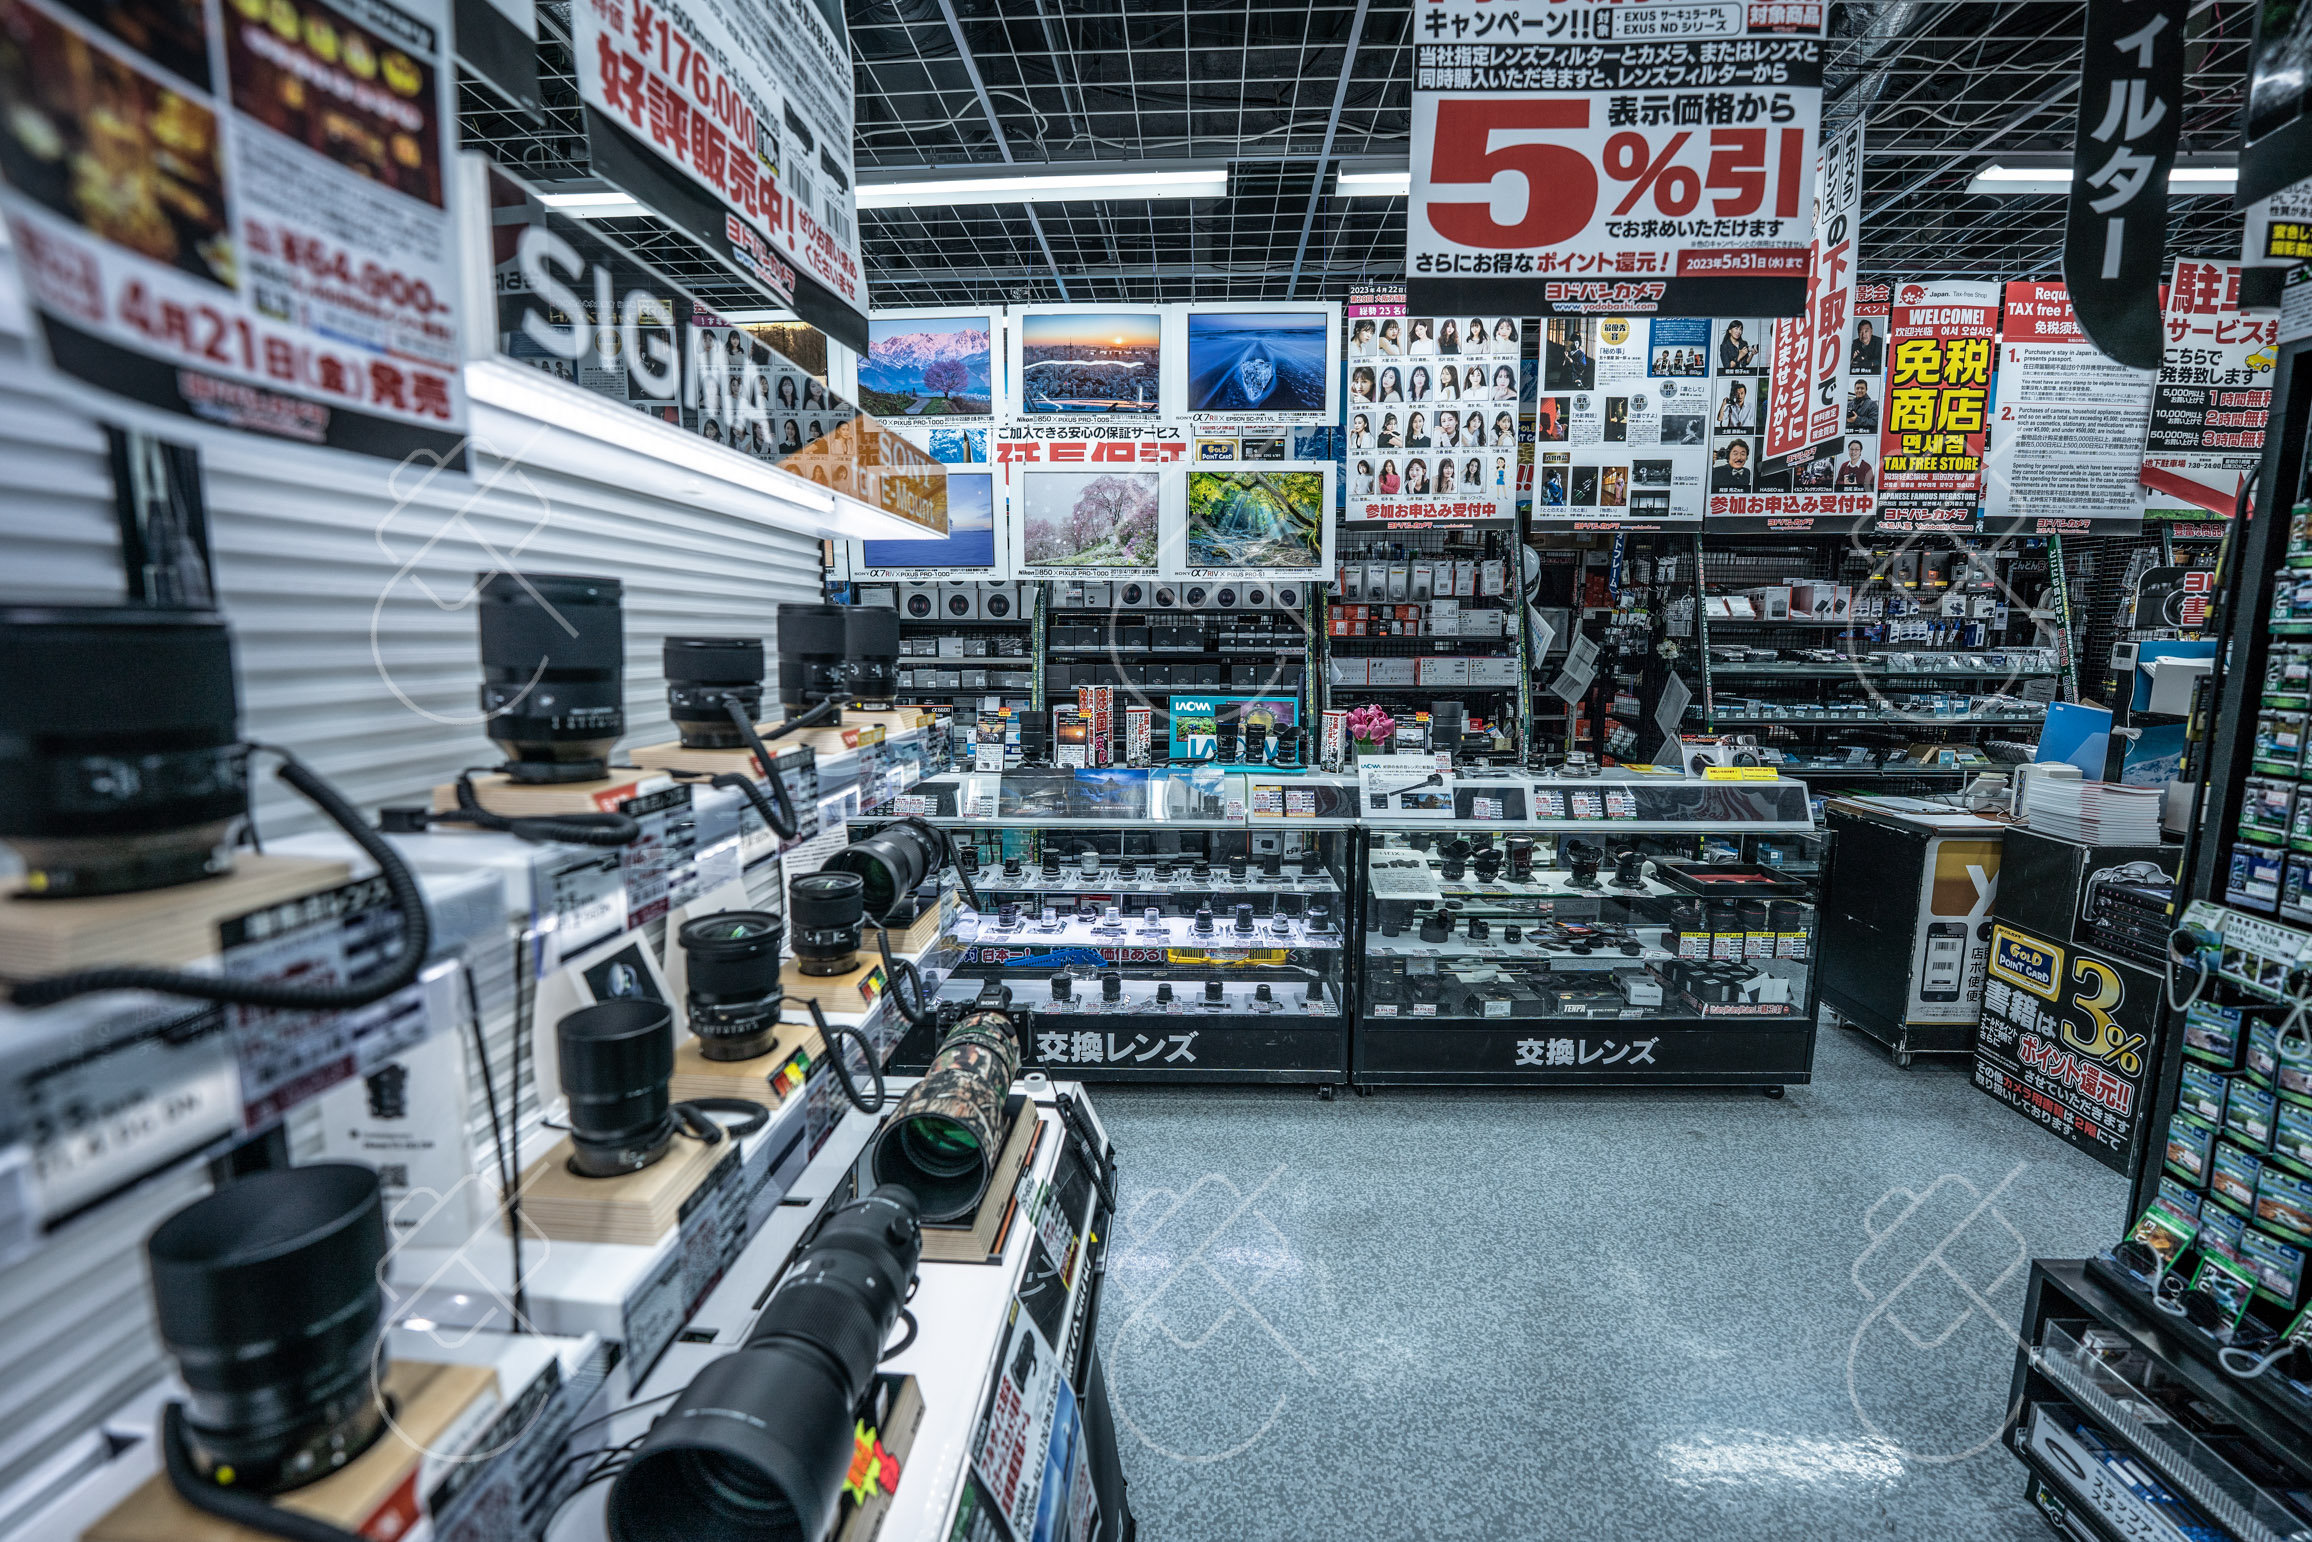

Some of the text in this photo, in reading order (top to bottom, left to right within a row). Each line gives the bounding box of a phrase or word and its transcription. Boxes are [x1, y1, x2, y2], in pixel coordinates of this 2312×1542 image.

[1424, 9, 1589, 39] キャンペーン!!
[1624, 12, 1657, 23] EXUS
[1710, 8, 1725, 19] PL
[1624, 20, 1727, 35] EXUS ND シリーズ
[1608, 93, 1796, 127] 表示価格から
[1604, 219, 1785, 241] でお求めいただけます
[1545, 281, 1667, 302] ヨドバシカメラ
[1379, 306, 1391, 316] 23
[1552, 301, 1659, 313] www.yodobashi.com
[2008, 303, 2061, 316] TAX free
[1909, 308, 1985, 325] WELCOME!
[517, 225, 774, 445] SIGMA
[2024, 348, 2056, 356] Purchaser's
[2057, 349, 2069, 357] stay
[2163, 348, 2223, 366] こちらで
[1892, 338, 1990, 386] 免税
[1888, 386, 1987, 433] 商店
[2001, 406, 2015, 421] 2.
[1883, 456, 1979, 471] TAX FREE STORE
[1710, 496, 1874, 515] 参加お申込み受付中
[1879, 493, 1977, 501] JAPANESE FAMOUS MEGASTORE
[1365, 502, 1497, 519] 参加お申込み受付中
[1885, 508, 1969, 521] ヨドバシカメラ
[1984, 979, 2058, 1039] 書籍は
[2060, 956, 2146, 1078] 3%
[1036, 1030, 1200, 1064] 交換レンズ
[1514, 1036, 1661, 1066] 交換レンズ
[2024, 1069, 2130, 1134] させていただきます
